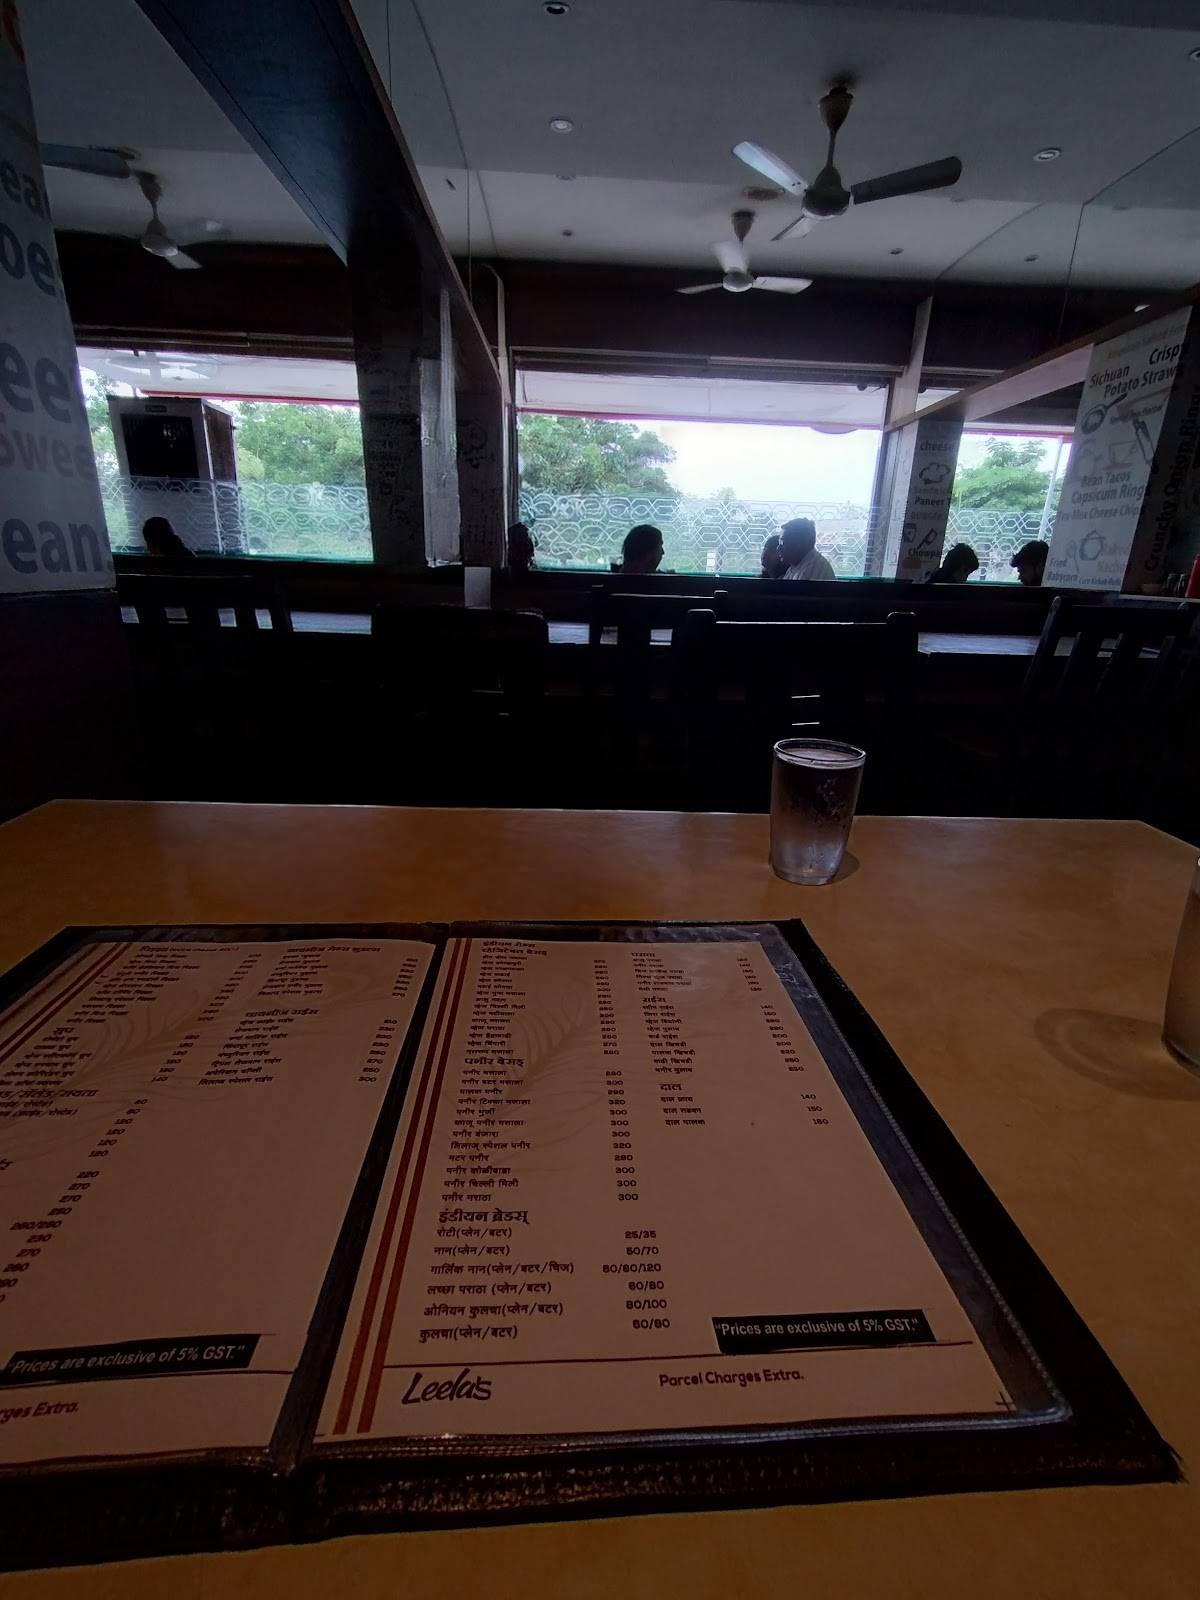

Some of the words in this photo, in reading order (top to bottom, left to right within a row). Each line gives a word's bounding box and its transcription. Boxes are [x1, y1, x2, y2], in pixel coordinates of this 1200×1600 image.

[1089, 365, 1130, 389] Sichuan
[1104, 377, 1141, 398] Potato
[618, 1193, 639, 1201] 300
[764, 1323, 785, 1336] are
[786, 1320, 846, 1335] exclusive
[848, 1320, 861, 1333] of
[862, 1319, 884, 1332] 5%
[60, 1356, 85, 1371] are
[87, 1350, 154, 1368] exclusive
[158, 1348, 176, 1364] of
[176, 1347, 200, 1362] 5%
[658, 1373, 704, 1388] Parcel
[705, 1369, 762, 1388] Charges
[763, 1367, 805, 1382] Extra.
